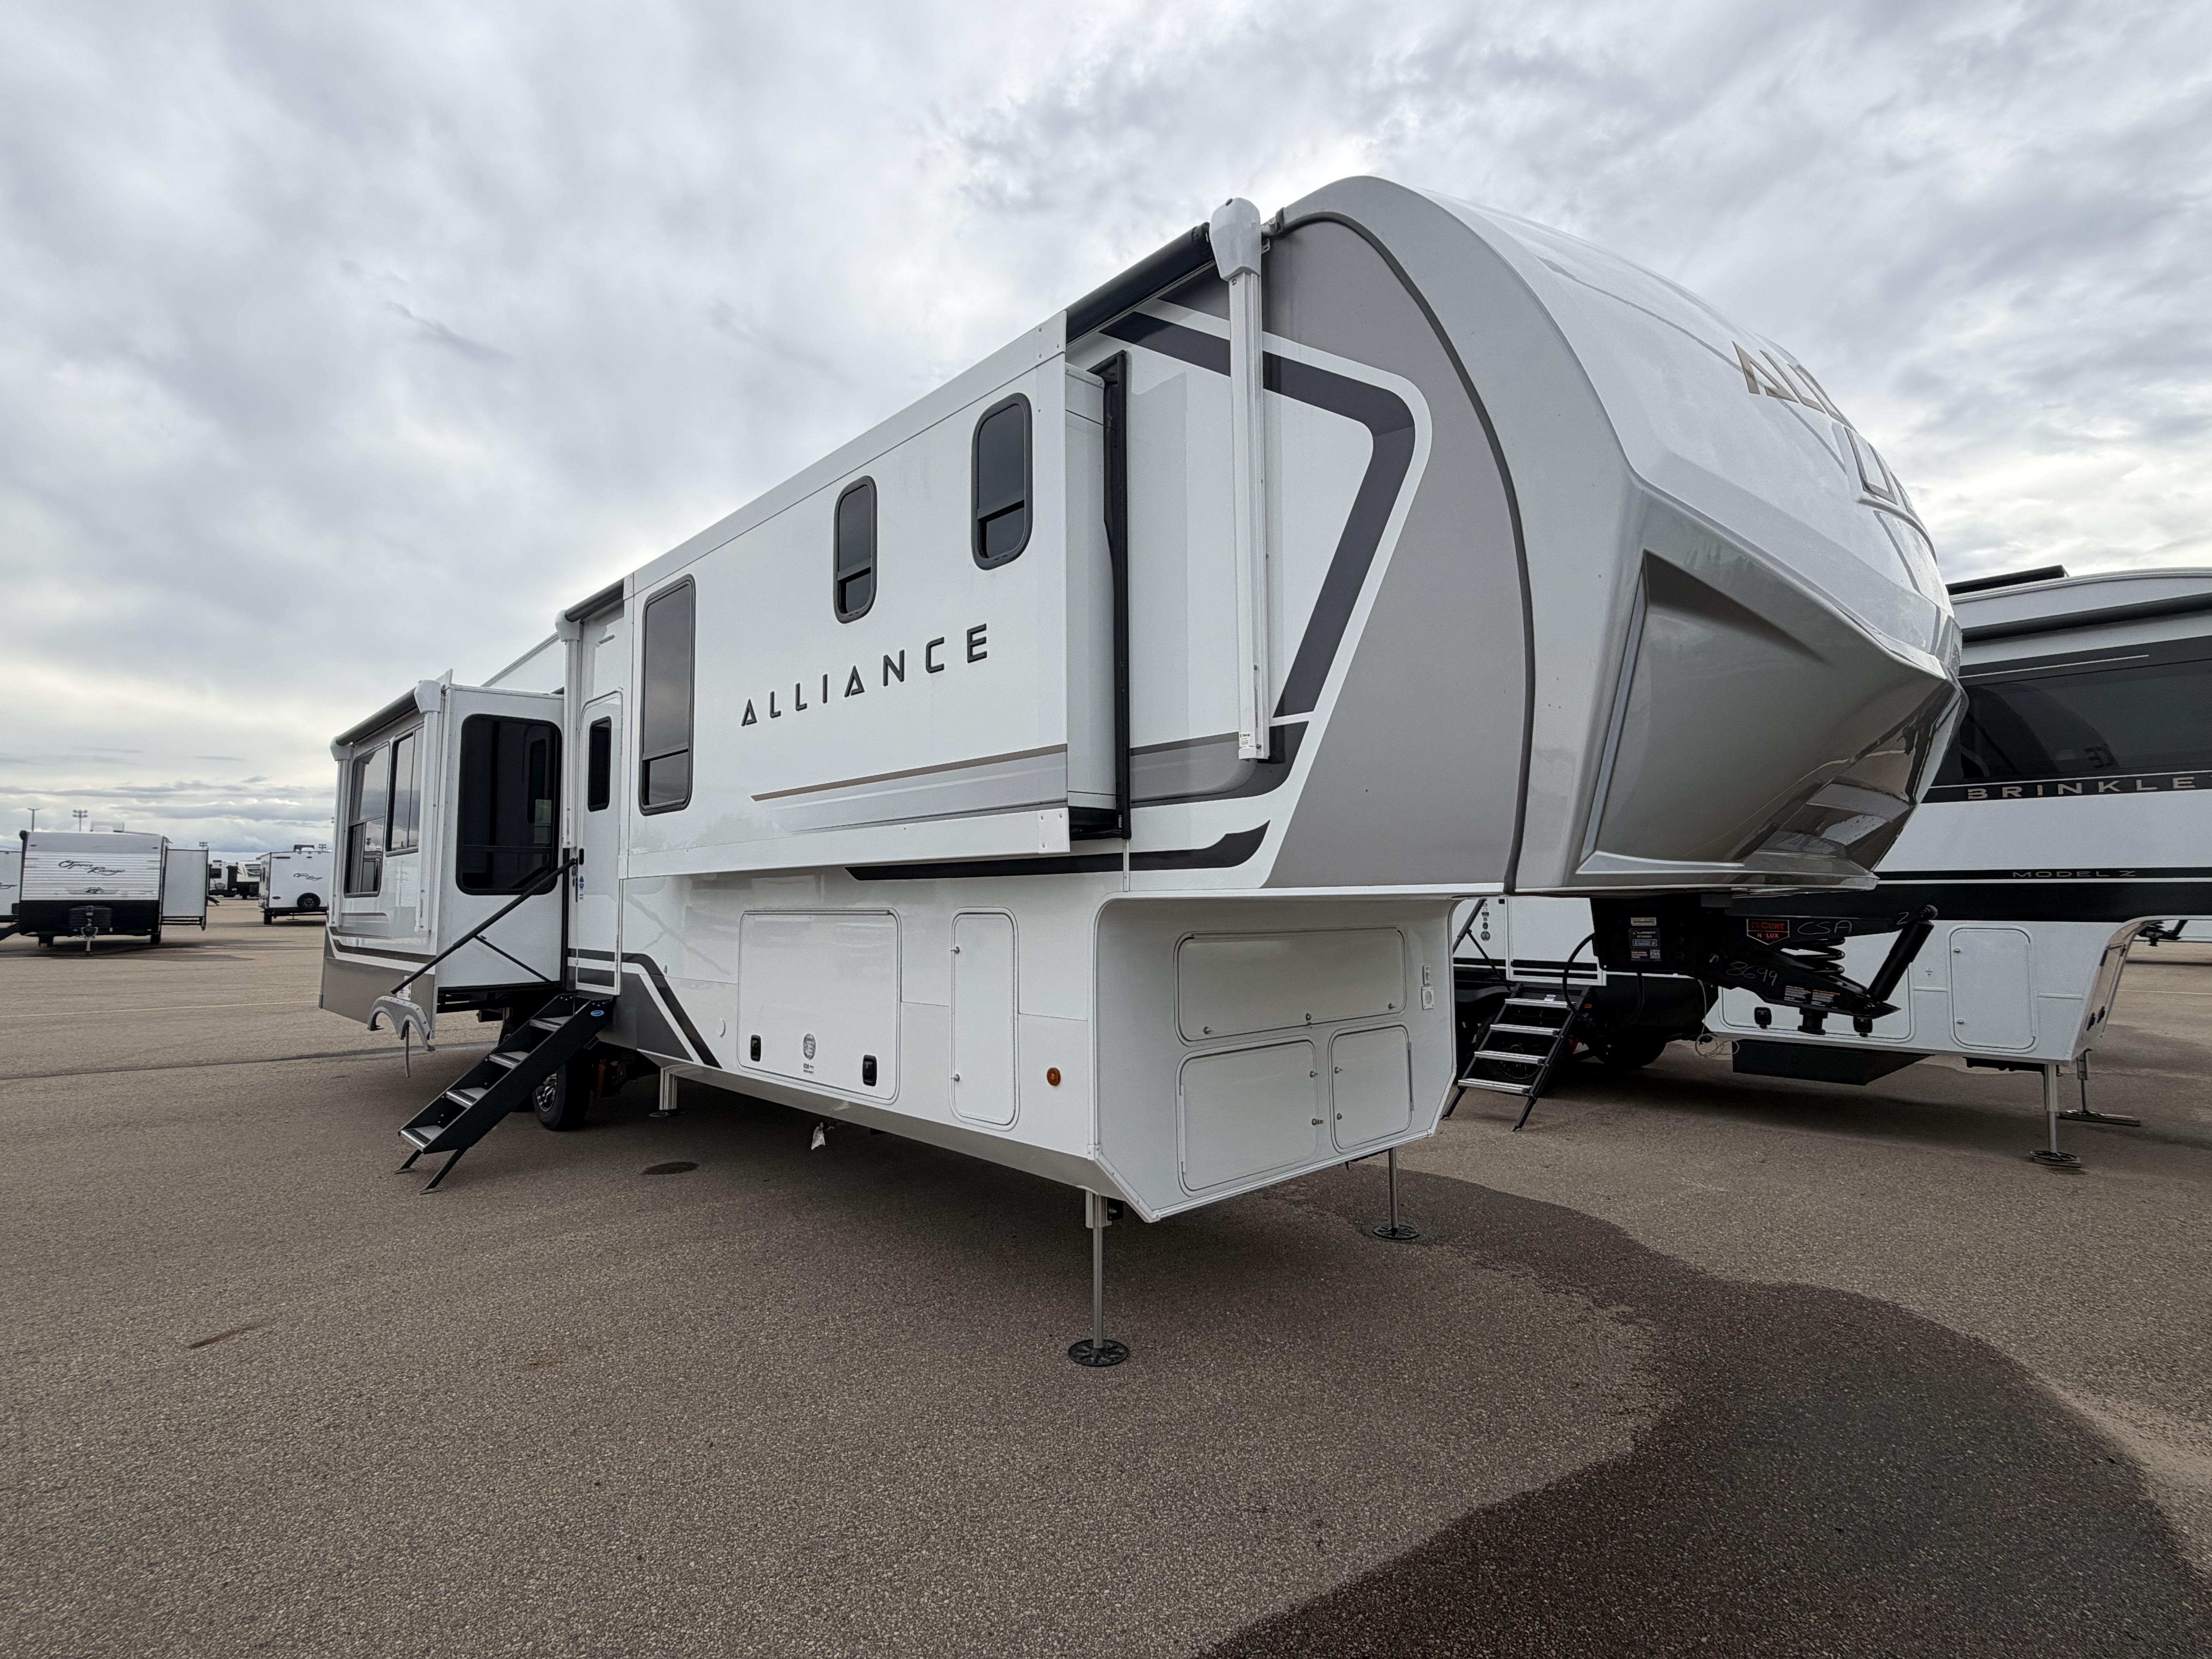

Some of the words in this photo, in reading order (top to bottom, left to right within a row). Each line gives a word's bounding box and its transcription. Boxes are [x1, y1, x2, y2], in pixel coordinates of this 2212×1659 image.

[741, 623, 988, 727] ALLIANCE
[1968, 775, 2212, 800] BRINKLE
[58, 860, 94, 869] Open
[1797, 920, 1853, 936] CSA
[1725, 960, 1778, 986] 8699
